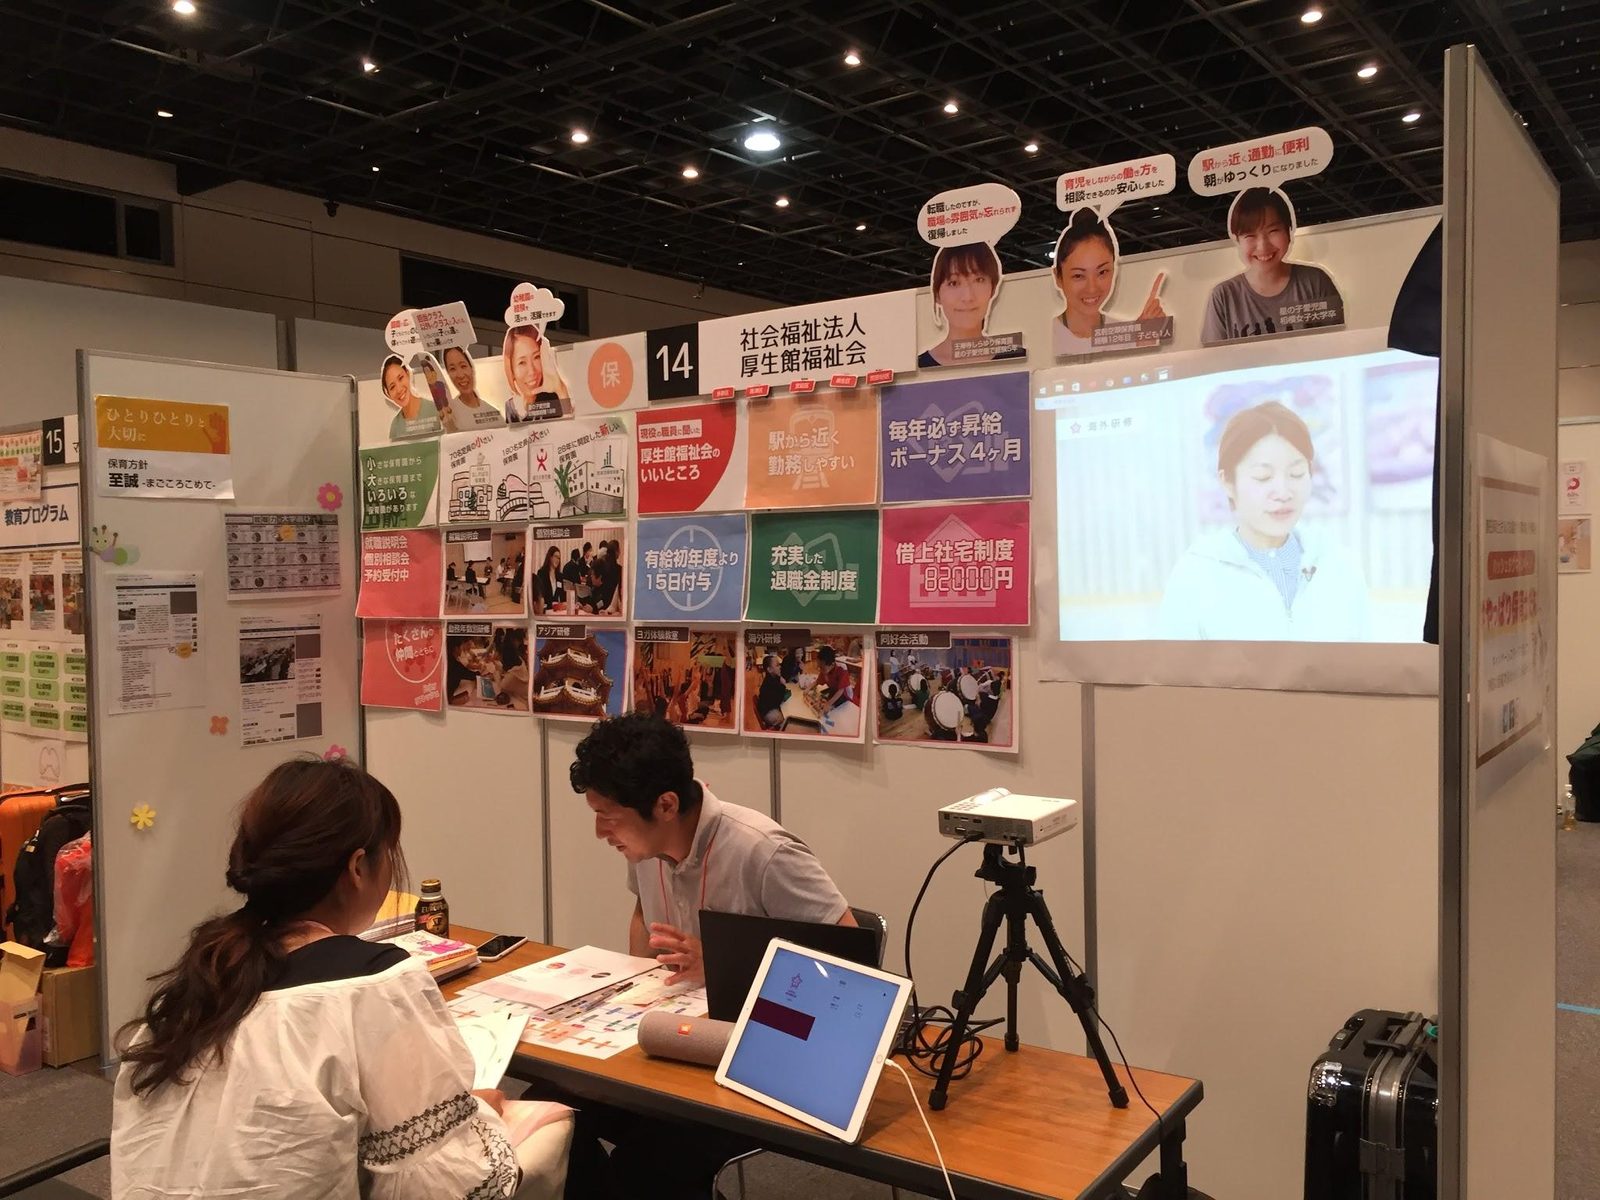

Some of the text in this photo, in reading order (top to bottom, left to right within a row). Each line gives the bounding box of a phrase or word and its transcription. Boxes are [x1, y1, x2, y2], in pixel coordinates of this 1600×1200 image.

[1202, 136, 1309, 172] 駅から近く通勤に便利
[1065, 163, 1157, 190] 育児をしながらの働き方を
[1204, 158, 1318, 187] 朝がゆっくりになりました
[1065, 180, 1164, 204] 相談できるのが安心しました
[927, 227, 968, 241] 復帰しました
[740, 312, 866, 351] 社会福祉法人
[655, 341, 694, 382] 14
[740, 340, 866, 378] 厚生館福祉会
[600, 361, 621, 388] 保
[888, 411, 1003, 442] 毎年必ず昇給
[46, 429, 63, 454] 15
[768, 427, 840, 451] 駅から近く
[107, 458, 148, 470] 保育方針
[640, 442, 720, 464] 厚生館福祉会の
[640, 465, 701, 483] いいところ
[768, 454, 855, 476] 勤務しやすい
[108, 472, 139, 488] 至誠
[4, 504, 69, 527] 教育プログラム
[364, 552, 410, 566] 個別相談会
[644, 547, 739, 569] 有給初年度より
[770, 545, 824, 566] 充実した
[896, 539, 1014, 565] 借上社宅制度
[364, 569, 410, 583] 予約受付中
[646, 572, 712, 592] 15日付与
[770, 569, 858, 592] 退職金制度
[924, 566, 1014, 592] 82000円
[537, 626, 571, 637] アジア研修
[636, 628, 679, 641] ヨガ体験教室
[748, 633, 783, 646] 海外研修
[880, 633, 930, 648] 同好会活動
